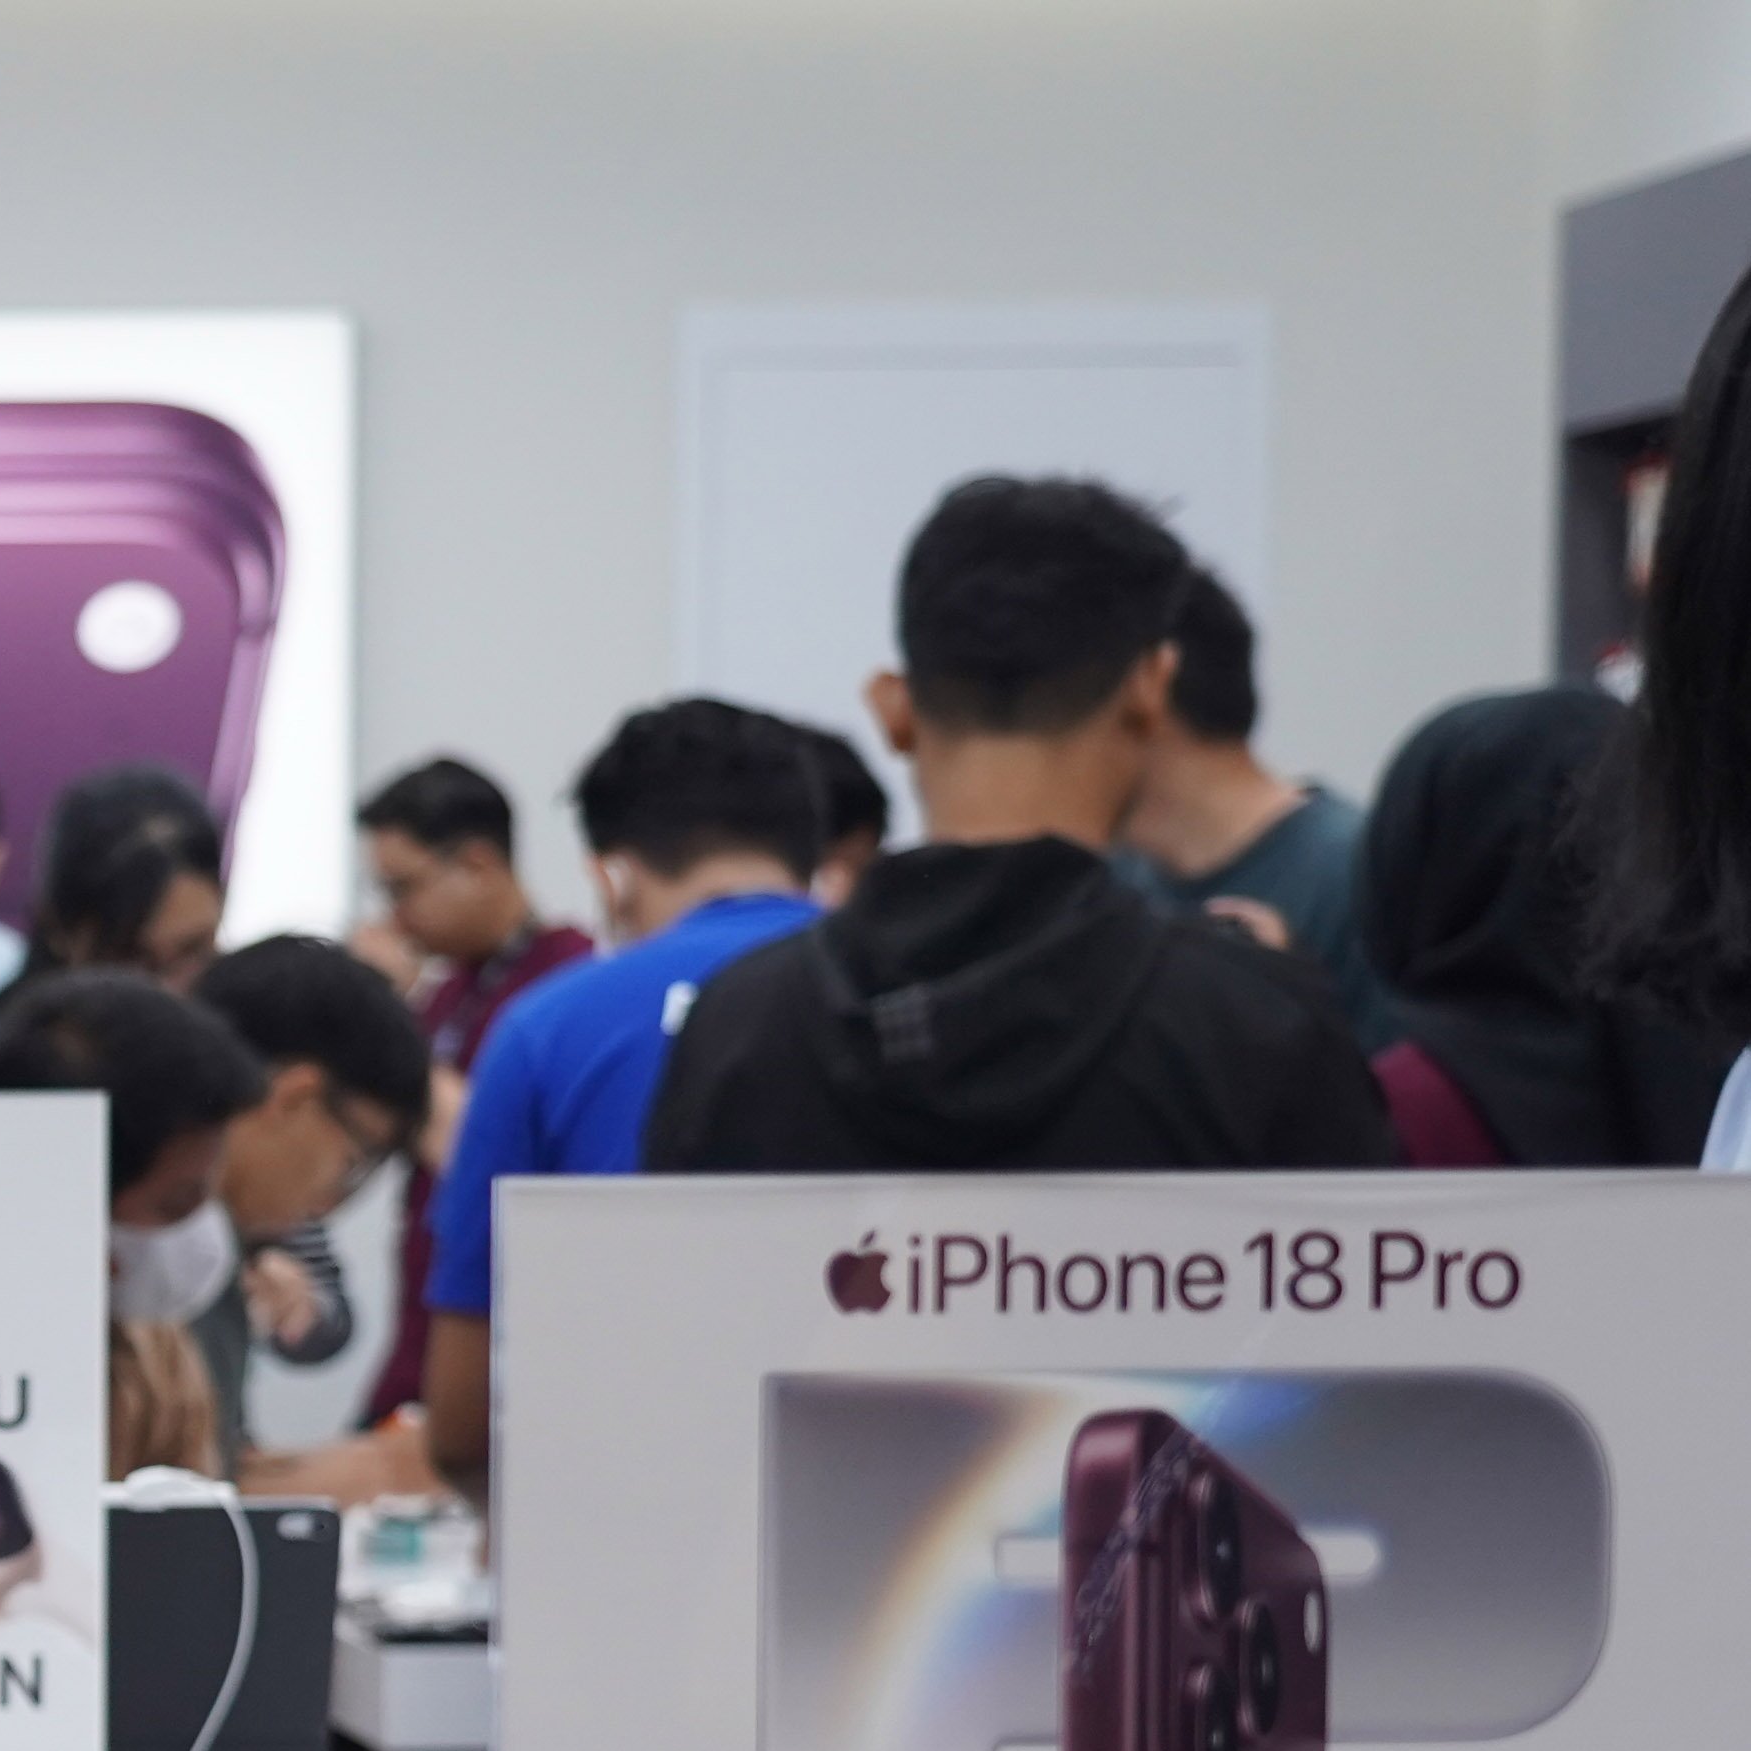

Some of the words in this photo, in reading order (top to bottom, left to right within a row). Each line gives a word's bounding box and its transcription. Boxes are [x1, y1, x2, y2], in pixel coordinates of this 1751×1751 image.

[908, 1233, 1230, 1315] iPhone
[1244, 1230, 1347, 1314] 18
[1369, 1230, 1524, 1313] Pro
